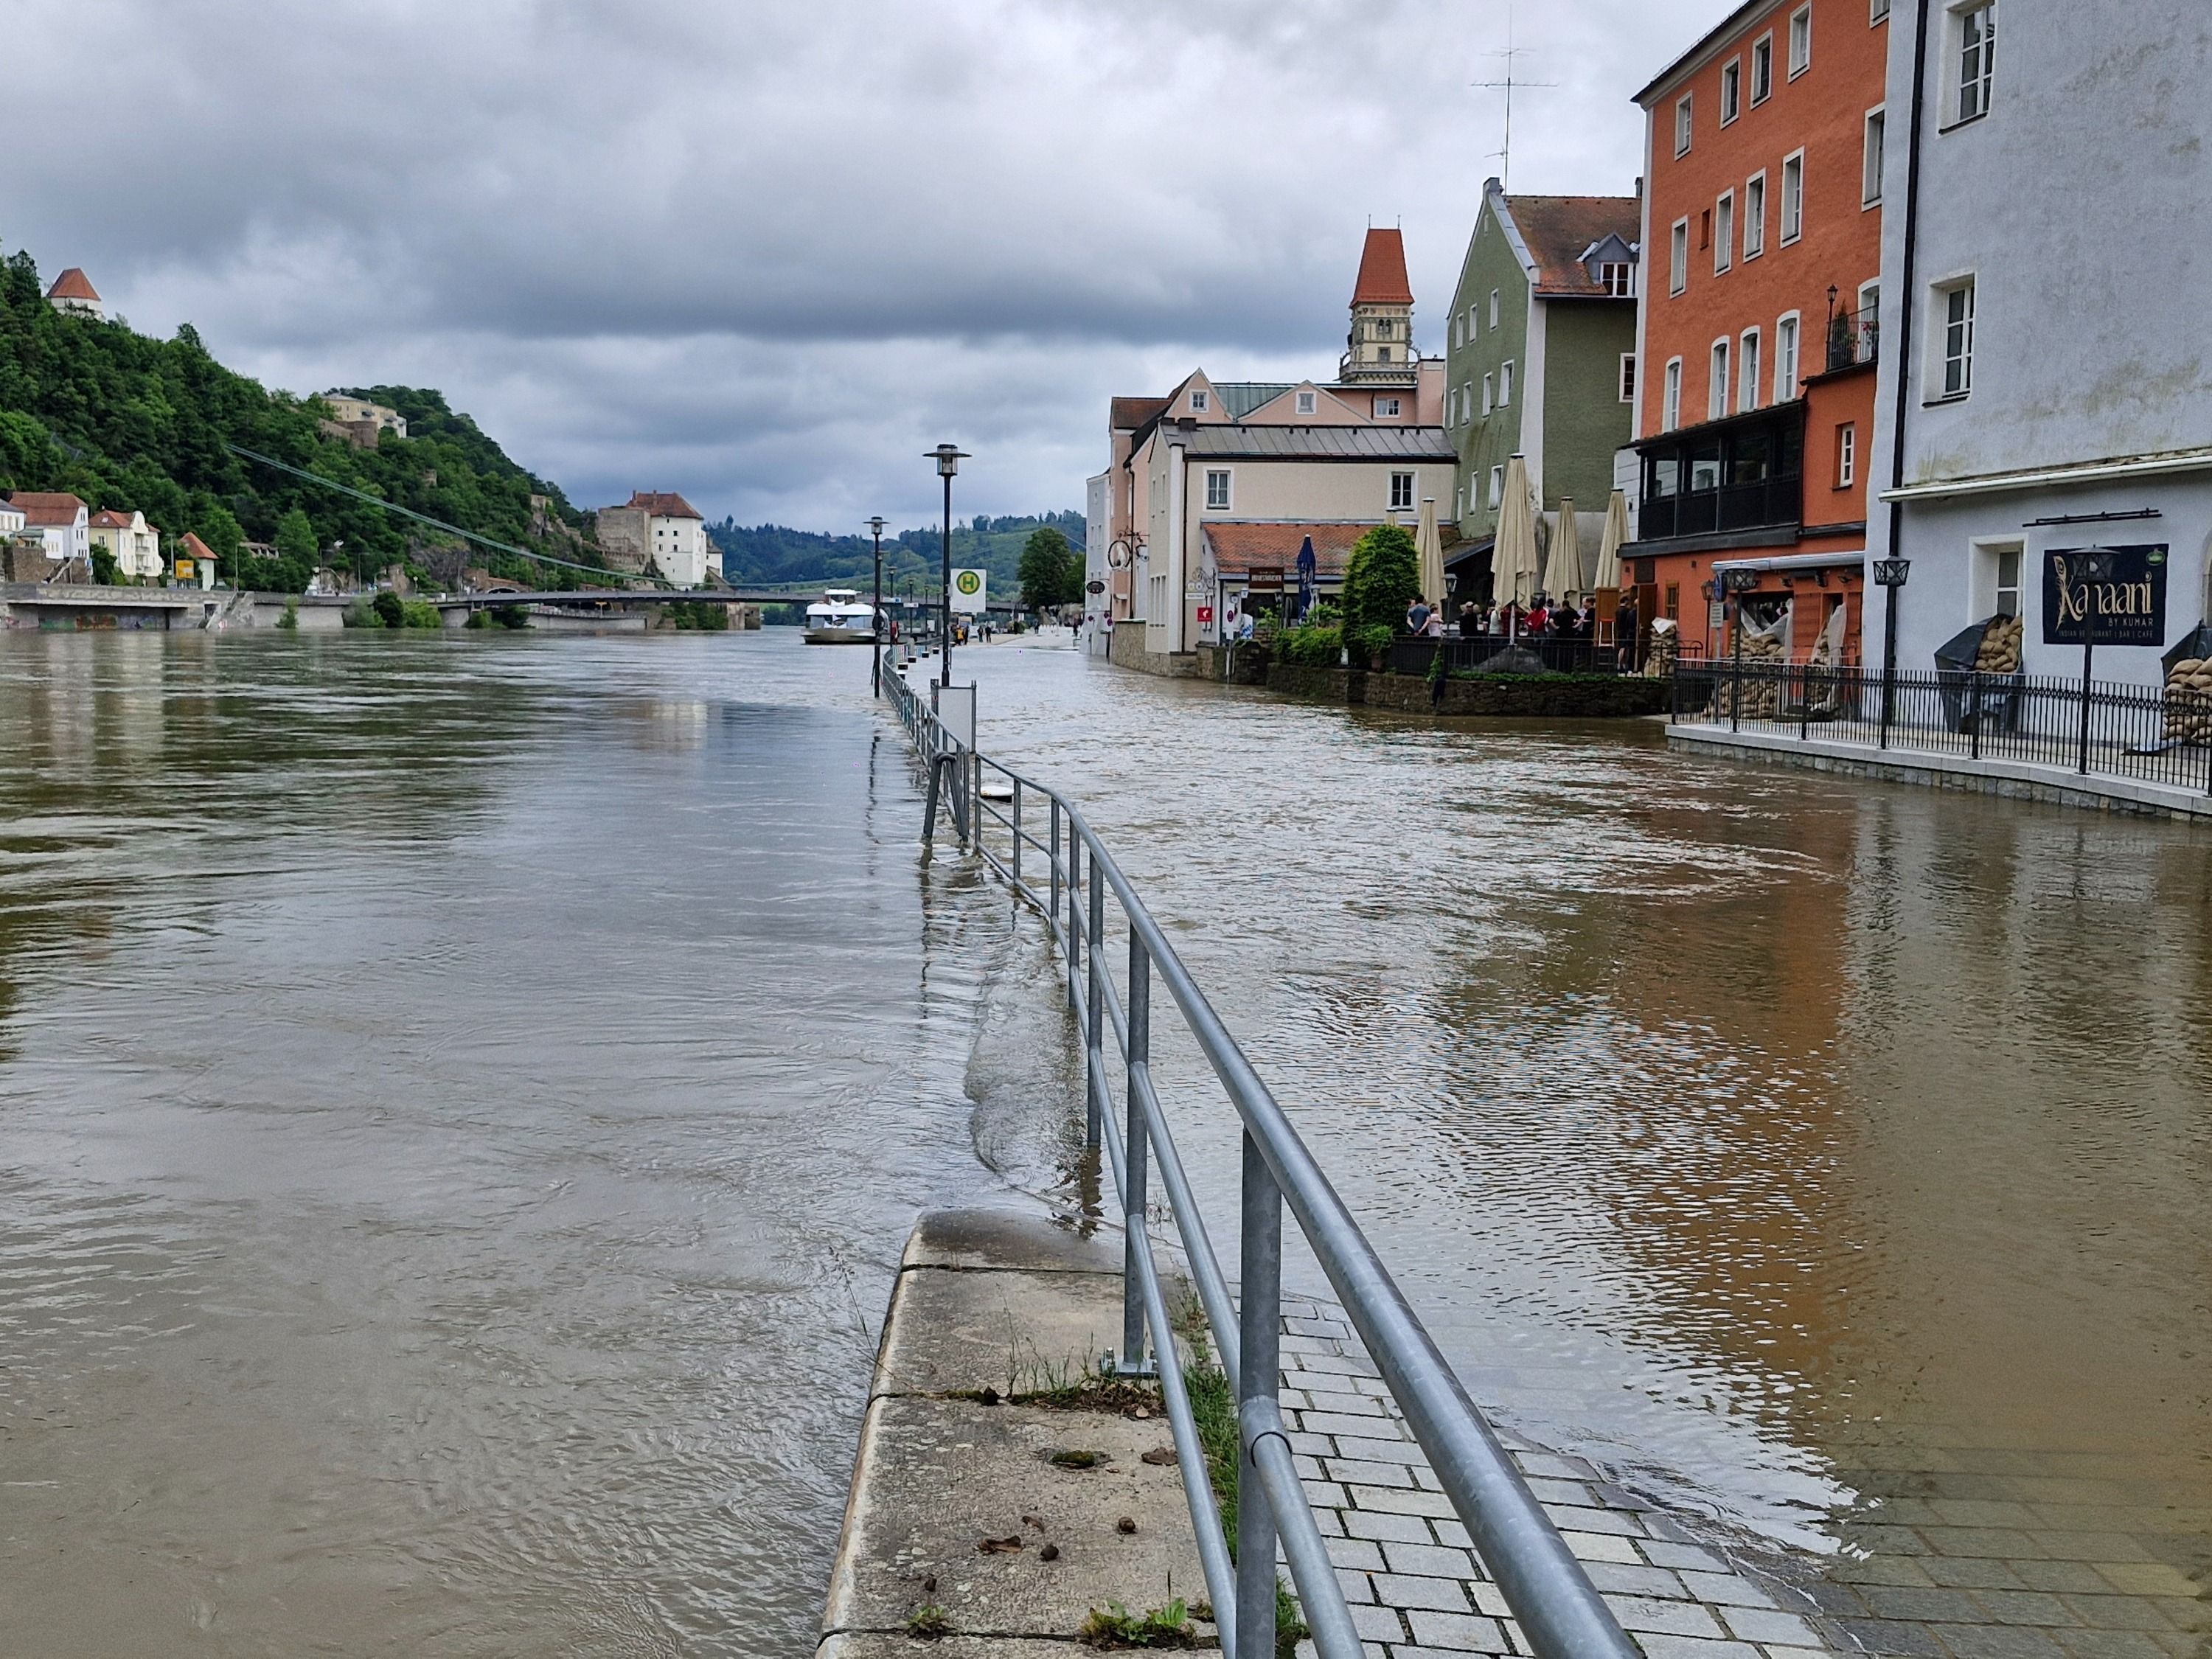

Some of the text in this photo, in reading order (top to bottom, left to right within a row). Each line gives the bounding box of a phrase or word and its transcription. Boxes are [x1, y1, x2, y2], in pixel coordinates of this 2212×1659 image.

[962, 576, 973, 588] H
[2108, 617, 2154, 627] BY KUMAR
[2119, 630, 2129, 639] BAR
